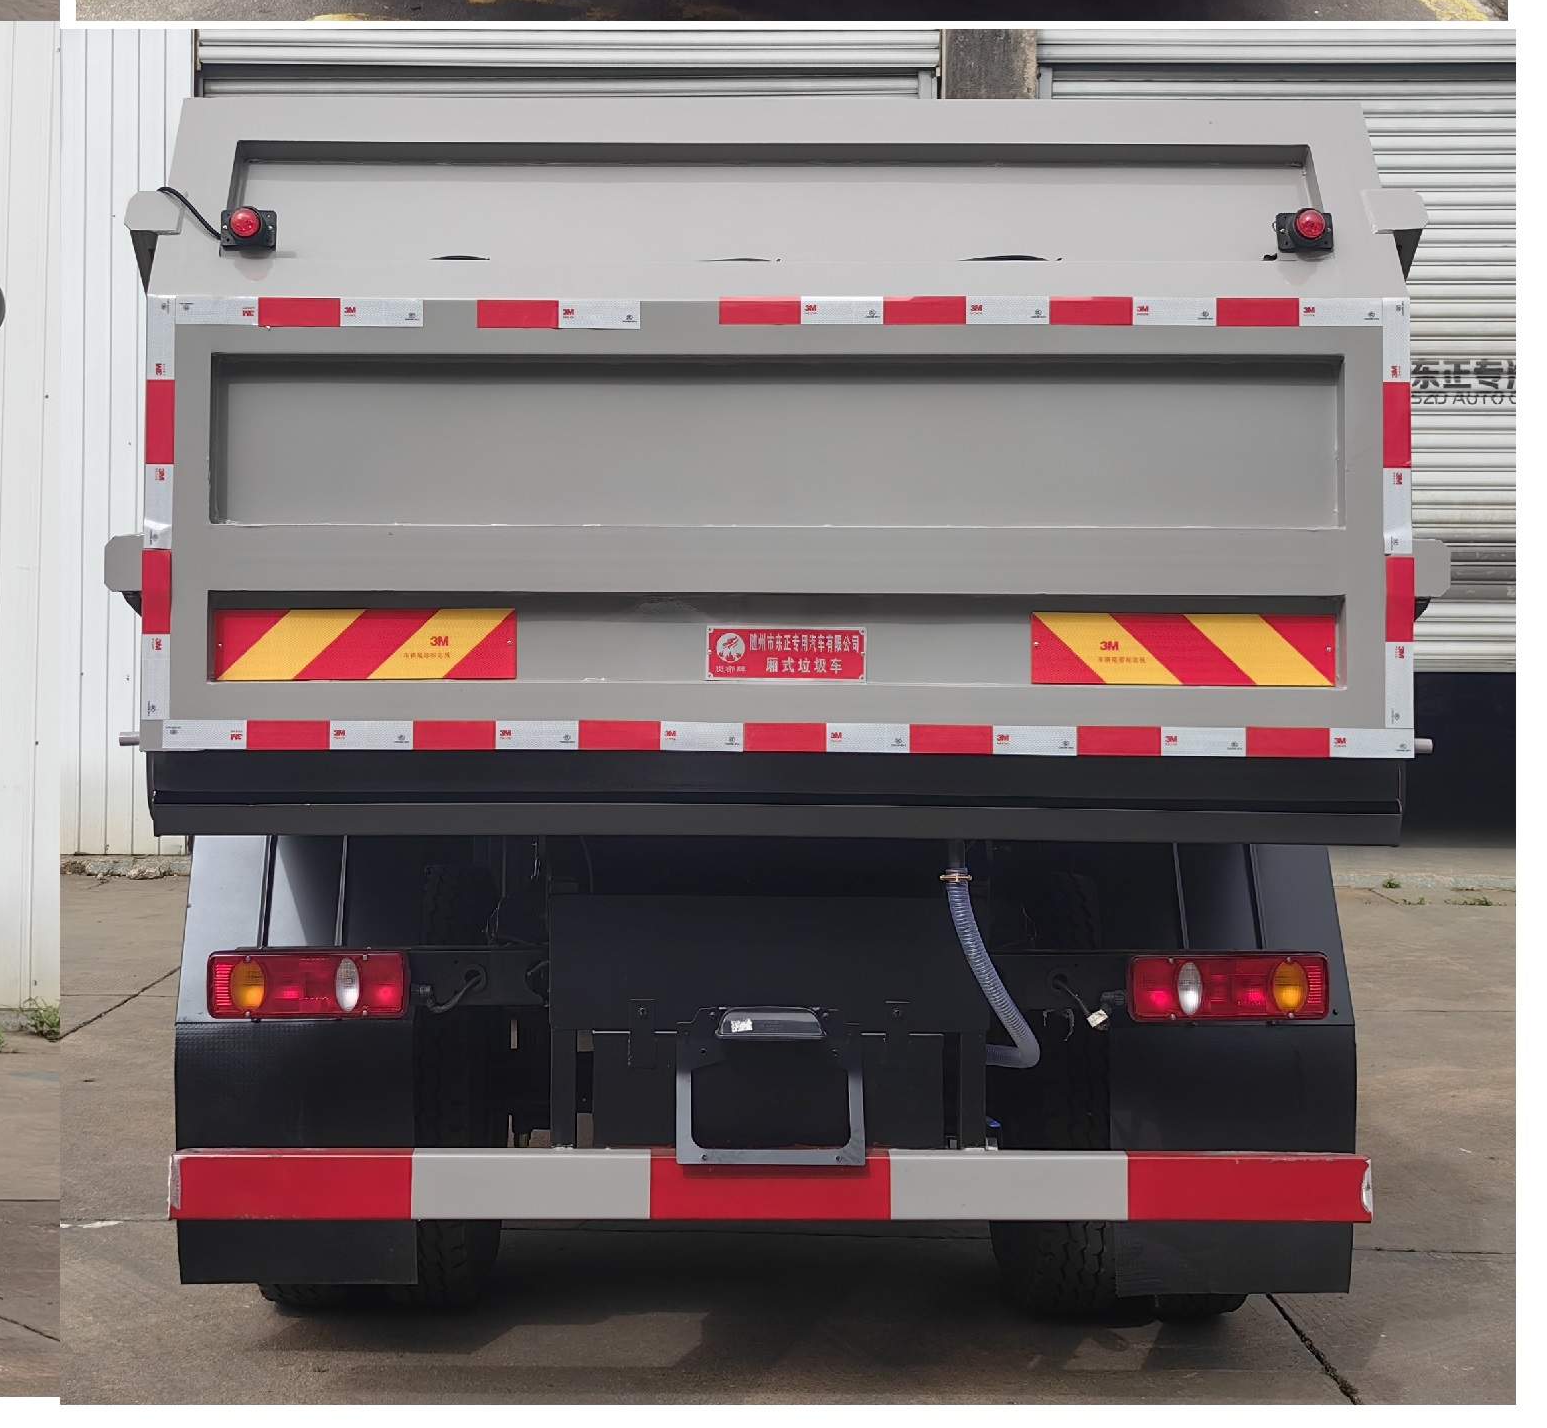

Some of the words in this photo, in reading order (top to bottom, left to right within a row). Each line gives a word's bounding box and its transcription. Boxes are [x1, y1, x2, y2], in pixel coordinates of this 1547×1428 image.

[1452, 393, 1505, 405] AUTO
[430, 635, 449, 647] 3M
[1099, 640, 1119, 652] 3M
[765, 657, 843, 674] 厢式垃圾车
